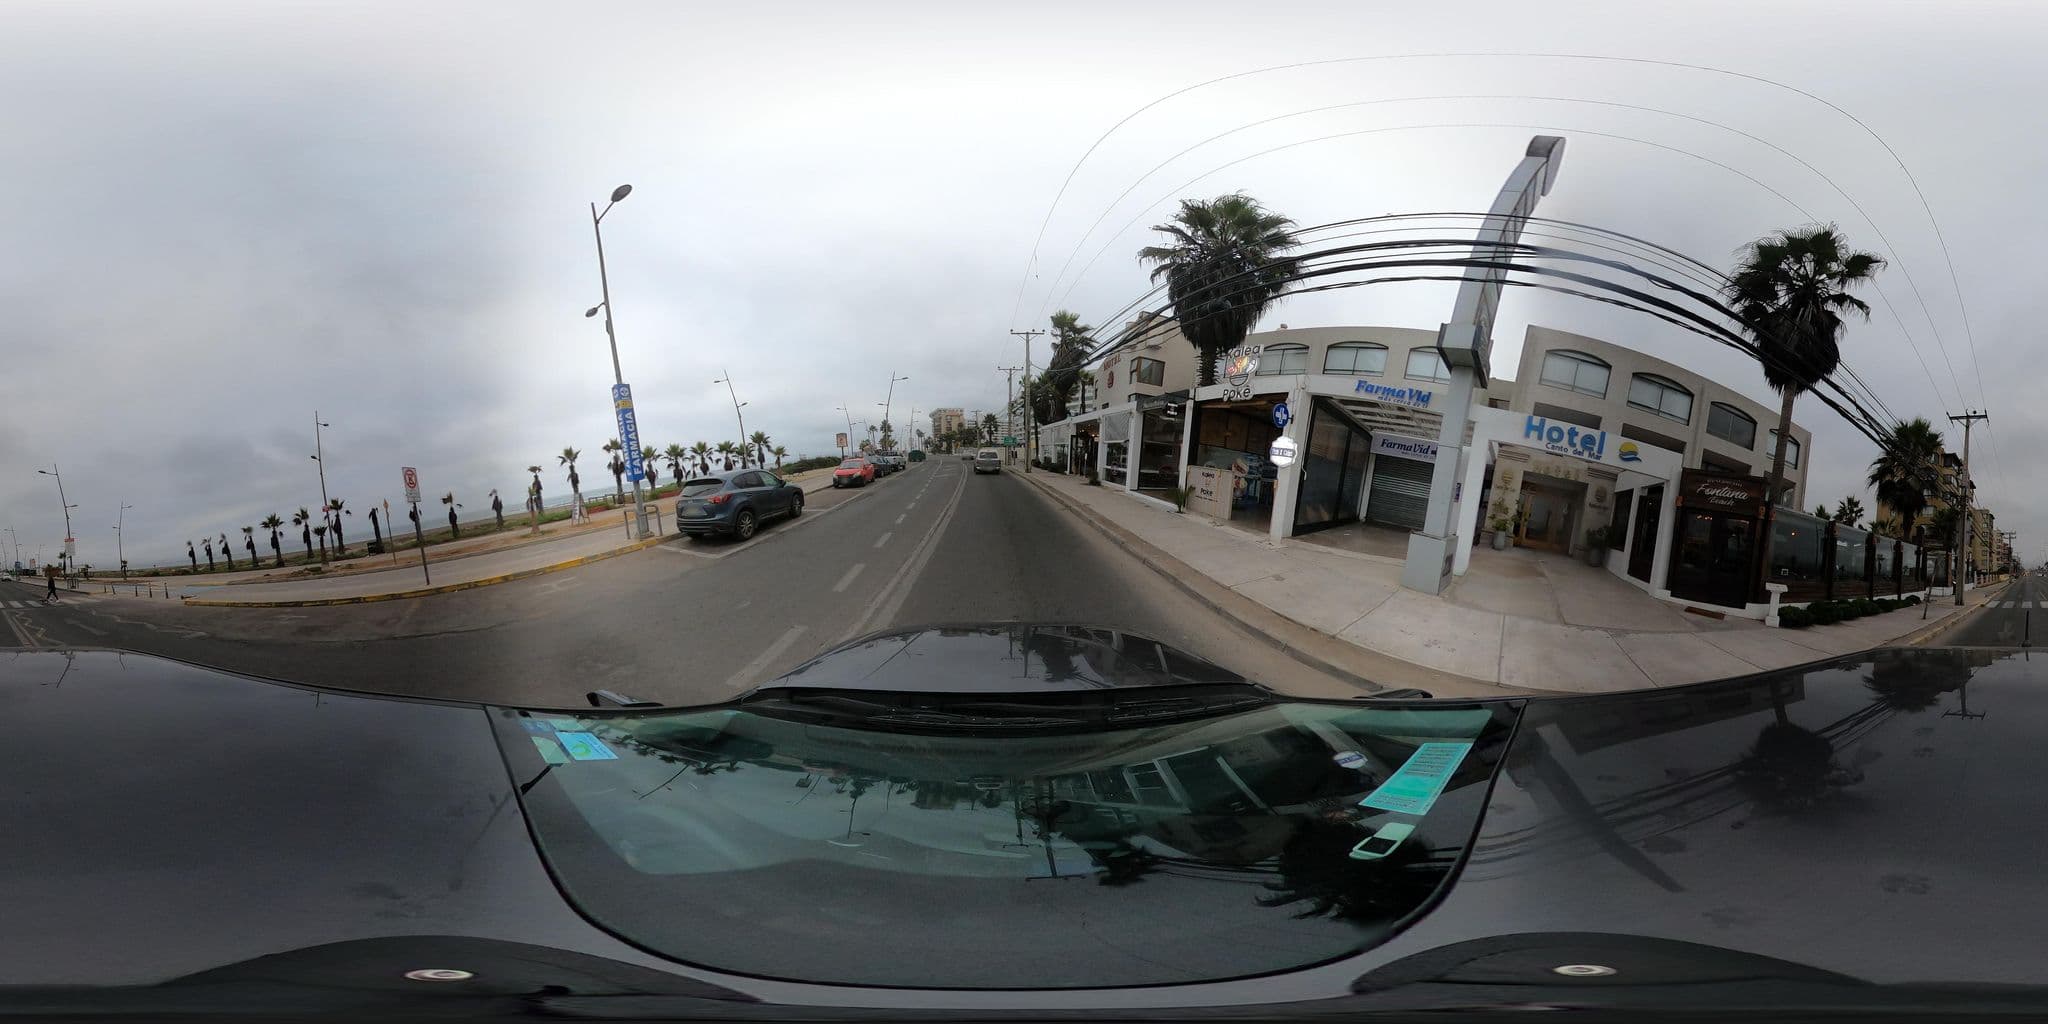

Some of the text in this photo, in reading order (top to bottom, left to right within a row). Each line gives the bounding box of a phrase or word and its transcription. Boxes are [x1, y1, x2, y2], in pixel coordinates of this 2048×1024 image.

[625, 411, 642, 475] FARMACIA
[1524, 415, 1607, 455] Hotel
[1380, 438, 1431, 455] FarmaVid
[1545, 442, 1602, 461] Canto del Mar
[1696, 483, 1748, 500] Fontana
